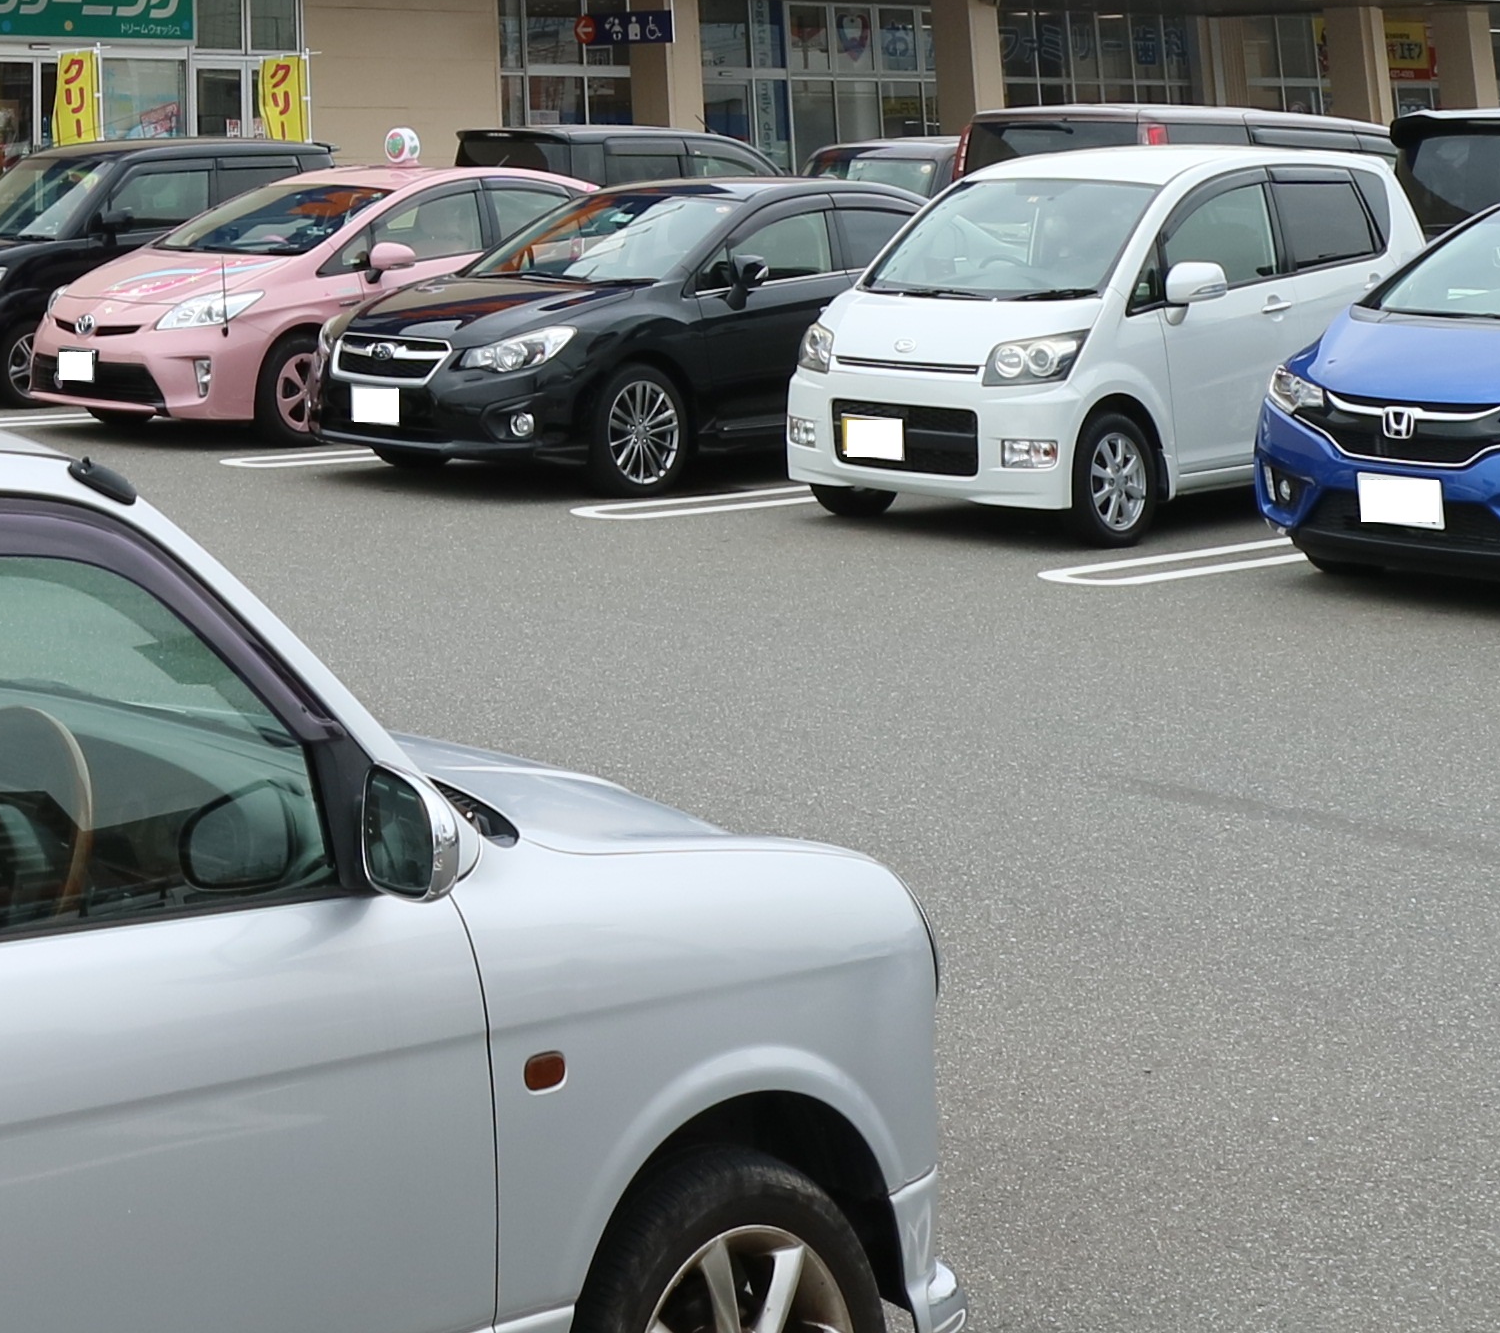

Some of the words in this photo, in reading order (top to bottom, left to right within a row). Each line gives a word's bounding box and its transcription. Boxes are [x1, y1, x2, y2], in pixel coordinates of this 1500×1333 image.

[121, 22, 181, 36] ドリームウォッシュ
